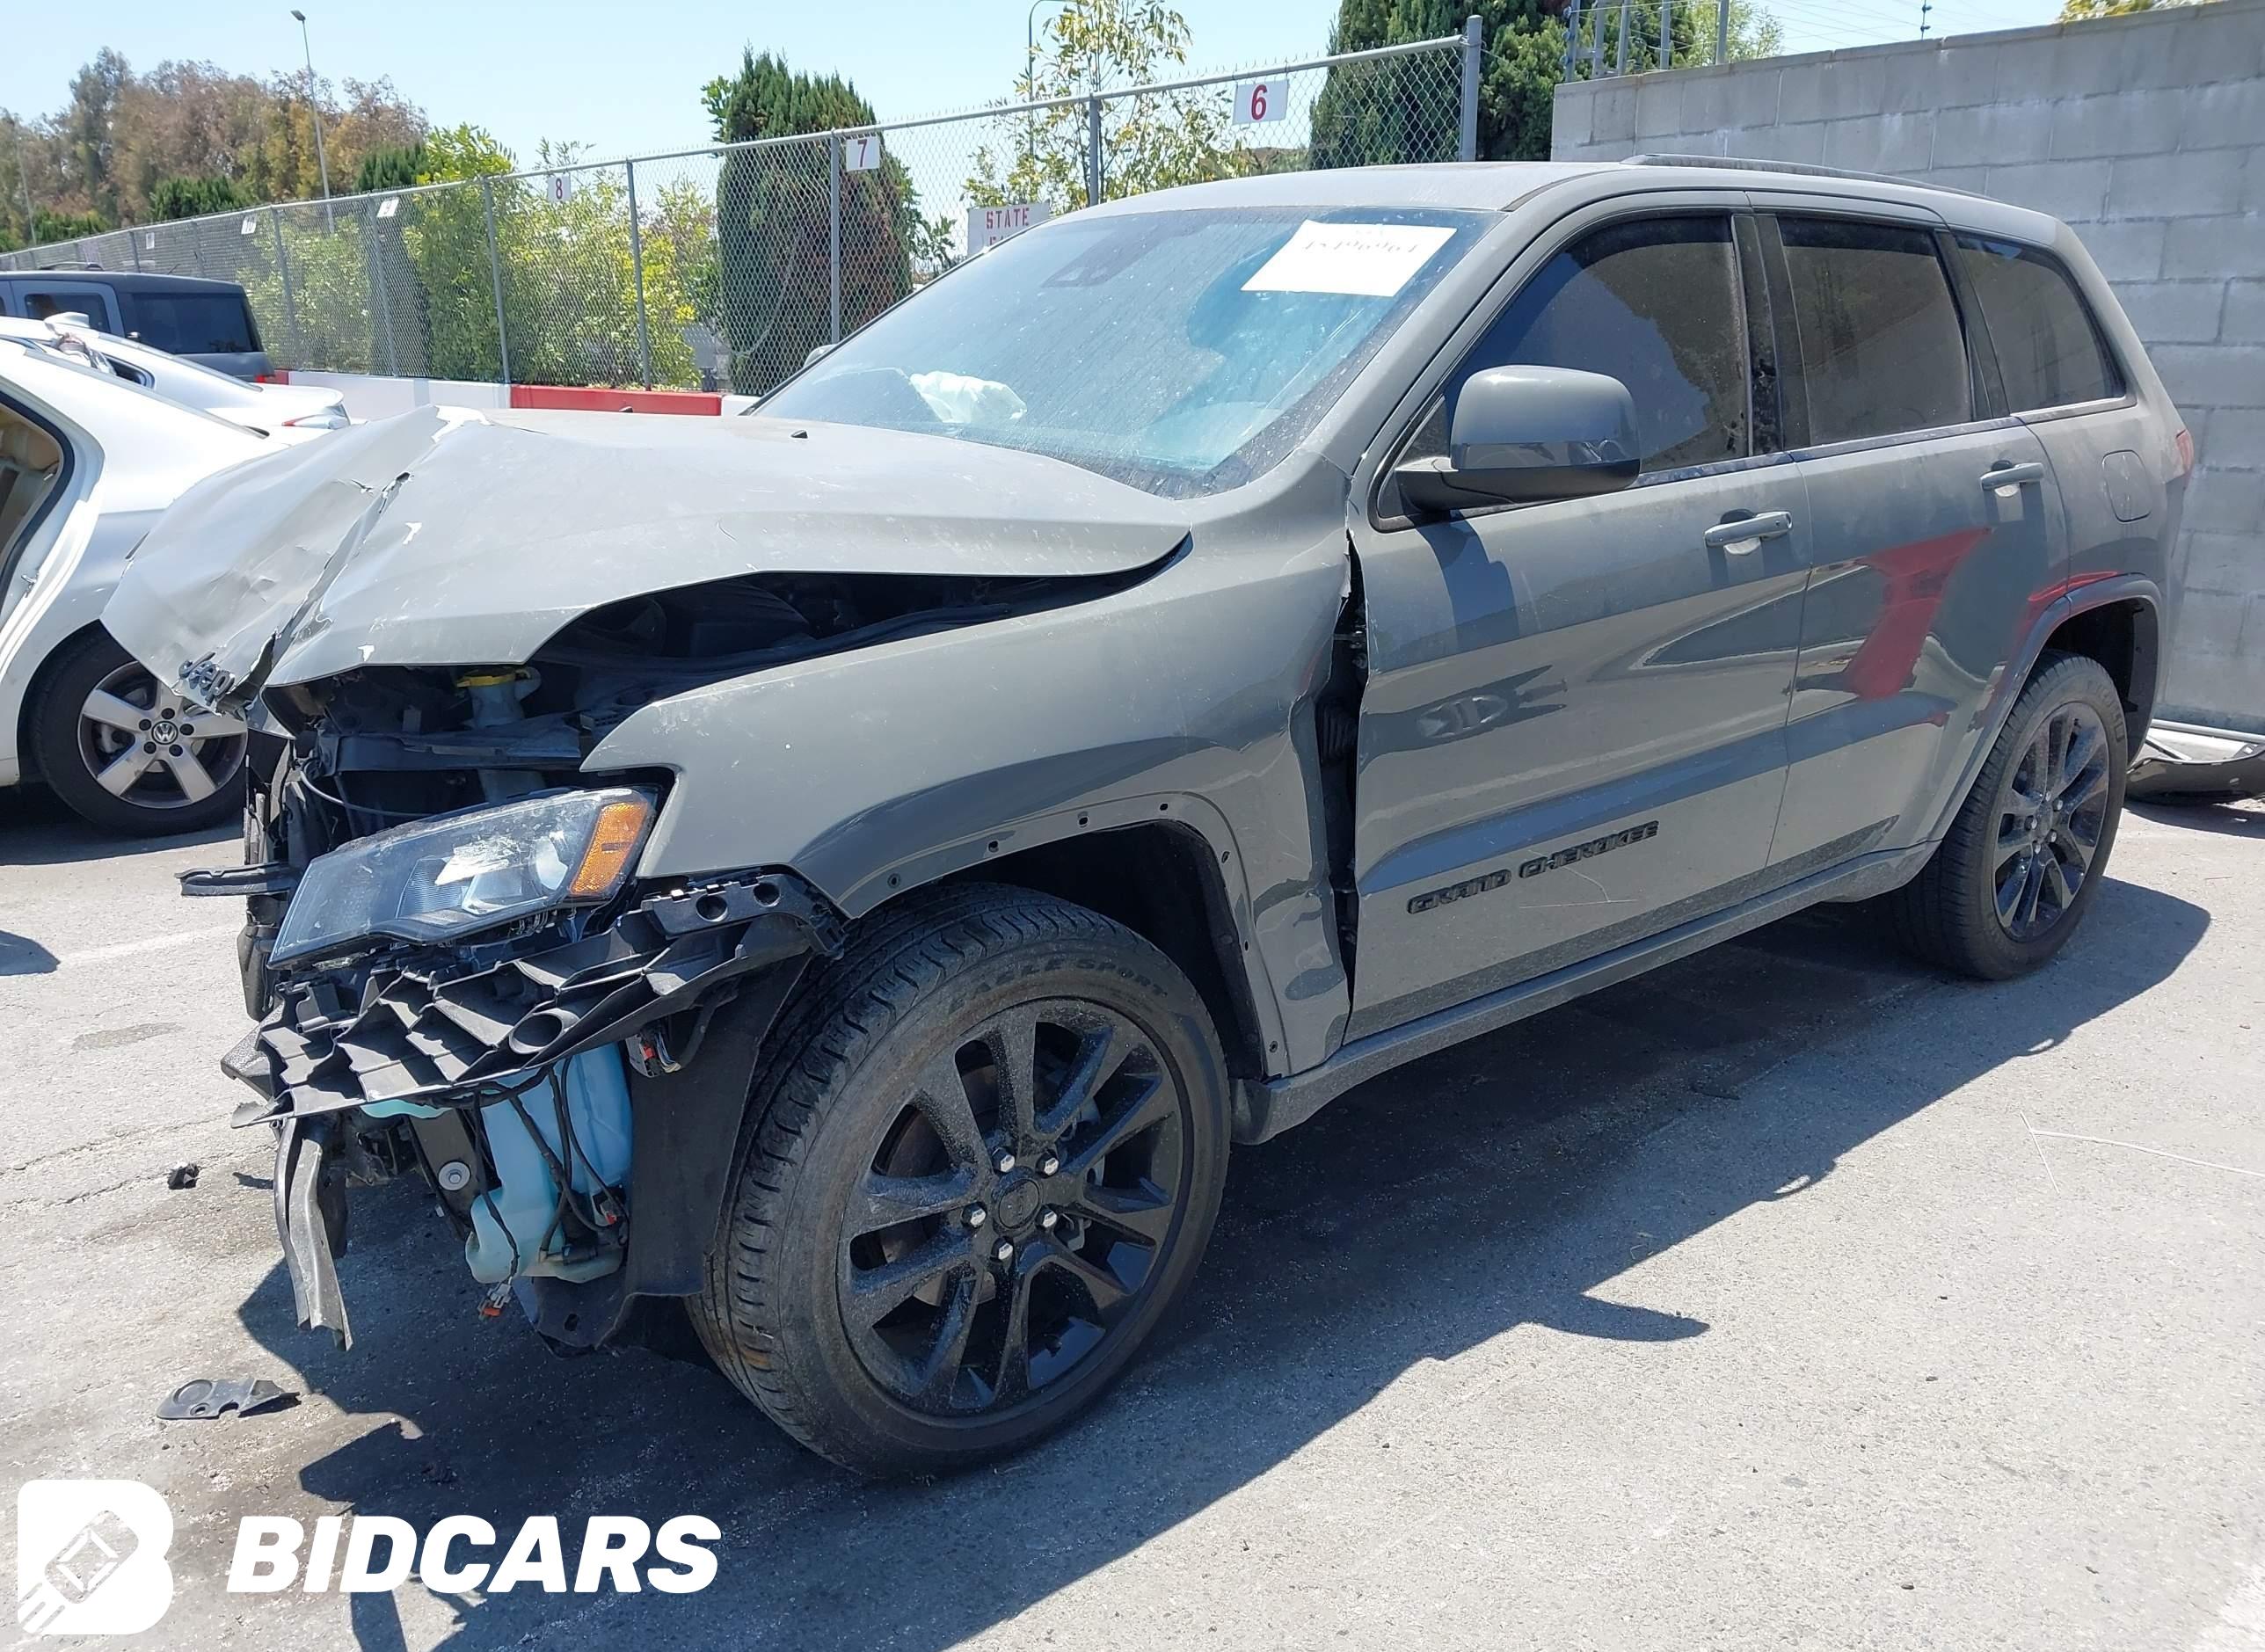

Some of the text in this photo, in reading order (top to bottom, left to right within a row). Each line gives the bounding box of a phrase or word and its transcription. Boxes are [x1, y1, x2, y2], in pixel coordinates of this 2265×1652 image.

[1251, 84, 1267, 120] 6
[857, 139, 868, 168] 7
[555, 178, 563, 200] 8
[986, 207, 1030, 229] STATE
[178, 651, 236, 706] Jeep
[1407, 820, 1660, 914] GRAND CHEROKEE
